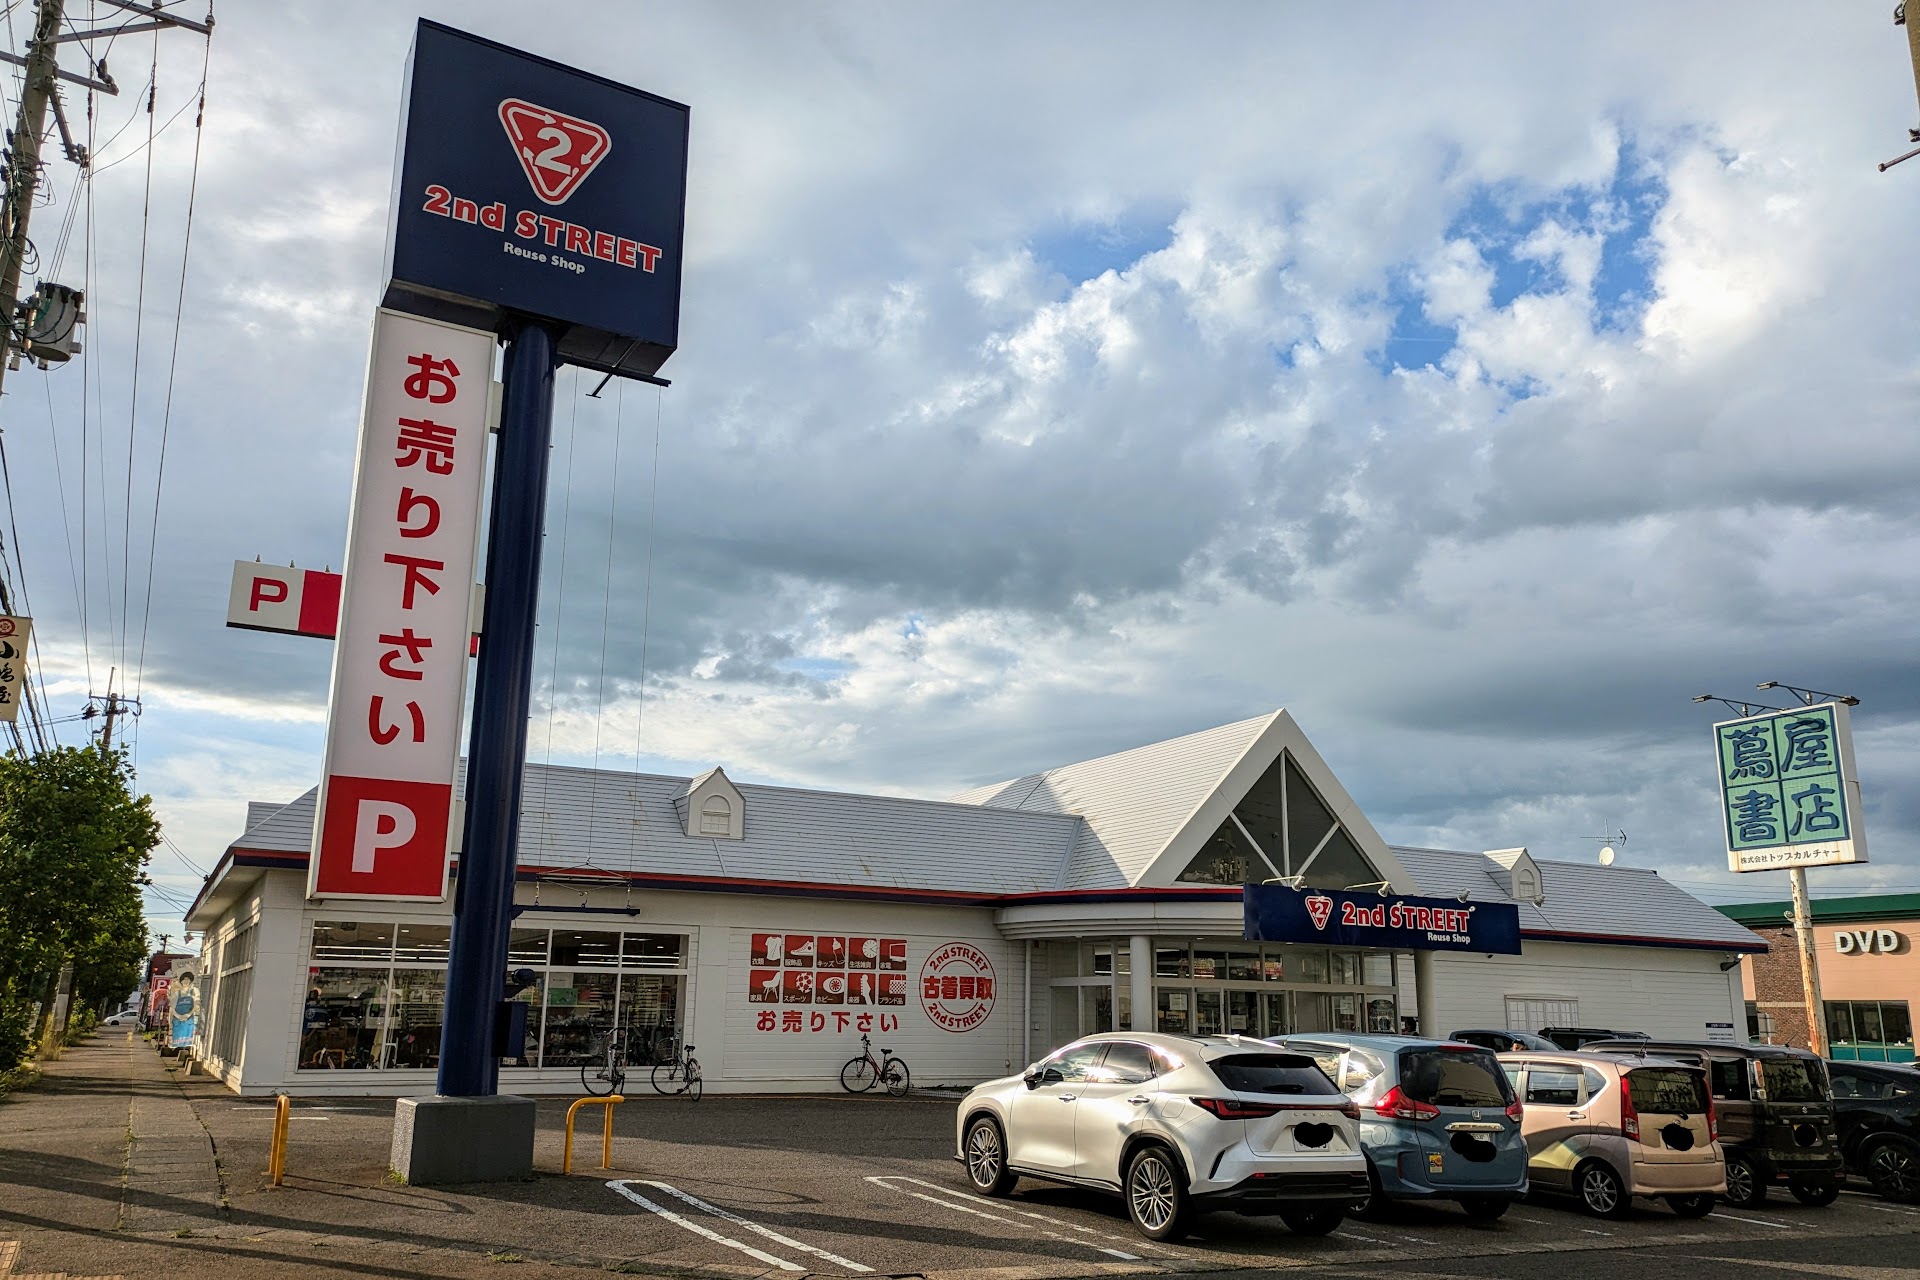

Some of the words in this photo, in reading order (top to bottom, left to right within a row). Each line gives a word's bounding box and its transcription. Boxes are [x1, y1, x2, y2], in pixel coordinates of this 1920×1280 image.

[534, 127, 572, 177] 2
[422, 184, 506, 232] 2nd
[515, 210, 662, 274] STREET
[503, 242, 547, 263] Reuse
[550, 255, 586, 275] Shop
[369, 353, 461, 745] お売り下さい
[249, 577, 289, 611] P
[351, 799, 417, 873] P
[1342, 901, 1386, 928] 2nd
[1390, 904, 1469, 933] STREET
[1427, 932, 1450, 942] Reuse
[1452, 933, 1471, 944] Shop
[1834, 930, 1898, 953] DVD
[817, 960, 835, 968] キッズ
[950, 946, 989, 972] STREET
[816, 995, 834, 1003] ホビー
[923, 975, 993, 1001] 古着買取
[757, 1010, 898, 1033] お売り下さい
[948, 1003, 987, 1028] STREET
